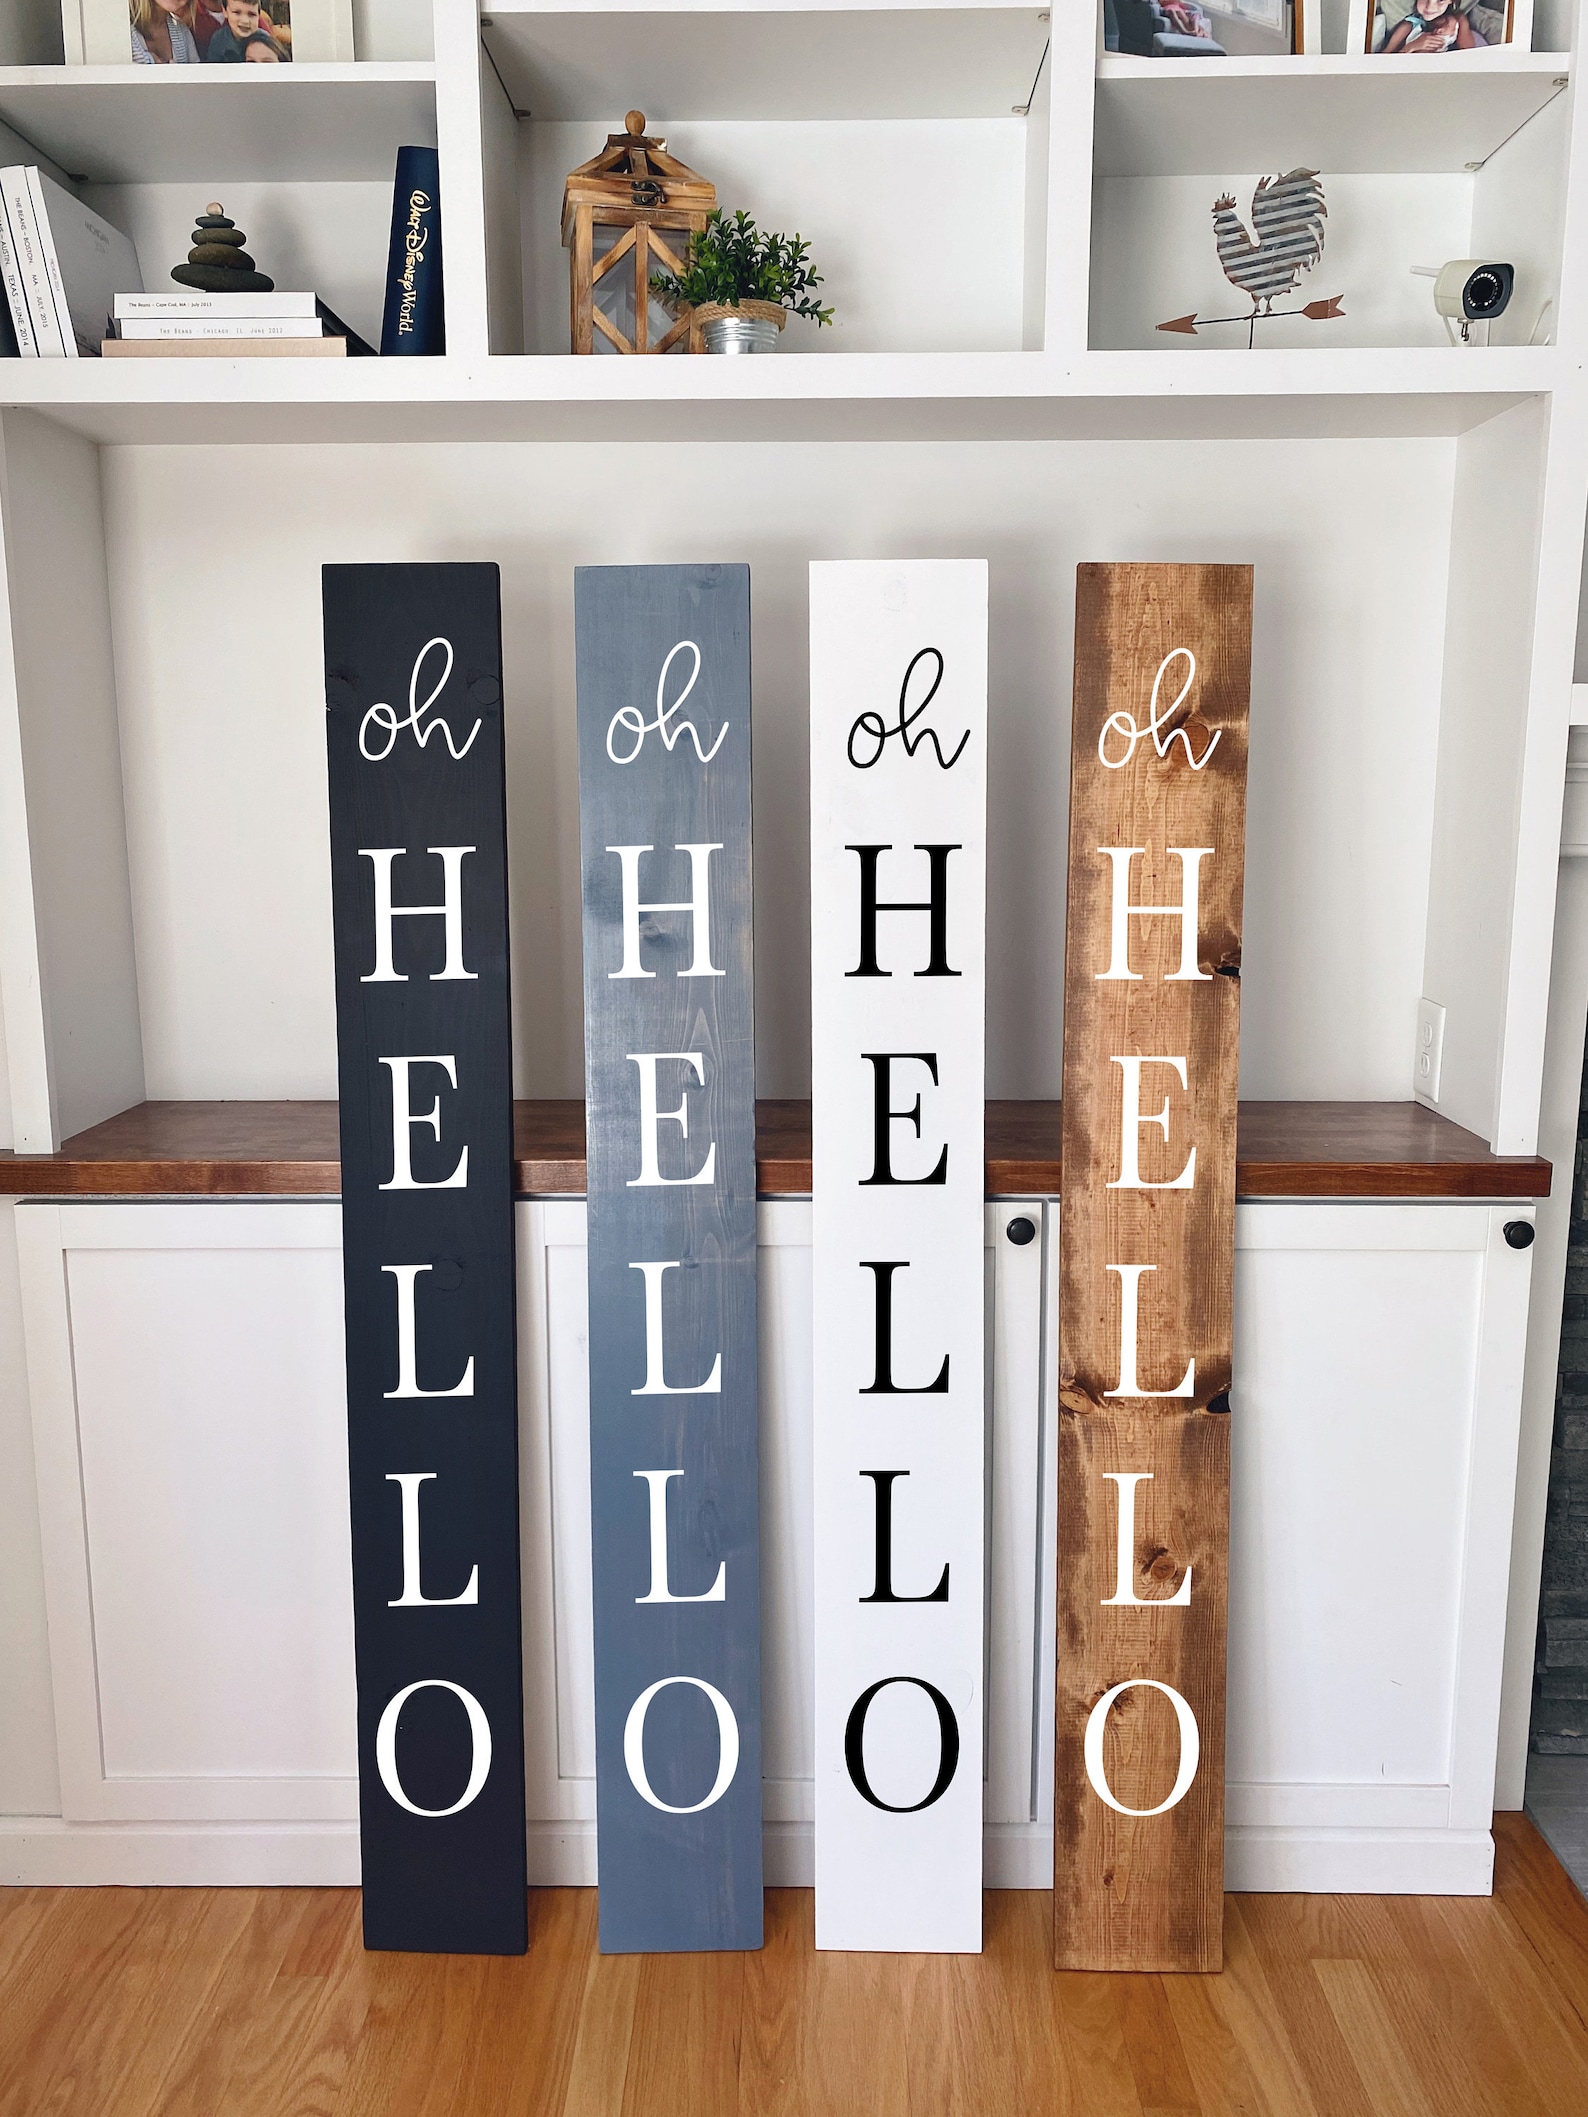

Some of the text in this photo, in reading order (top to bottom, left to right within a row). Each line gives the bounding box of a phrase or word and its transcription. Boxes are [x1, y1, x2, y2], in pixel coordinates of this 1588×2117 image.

[14, 197, 22, 208] THE
[17, 210, 27, 231] BEANS
[8, 274, 19, 297] TEXAS
[20, 328, 30, 346] 2014
[32, 274, 39, 286] MA
[40, 313, 48, 328] 2015
[359, 638, 481, 761] oh
[607, 641, 730, 765] oh
[847, 647, 971, 769] oh
[1098, 647, 1222, 770] oh
[359, 847, 492, 1816] HELLO
[606, 844, 739, 1813] HELLO
[844, 844, 963, 1812] HELLO
[1085, 847, 1214, 1817] HELLO
